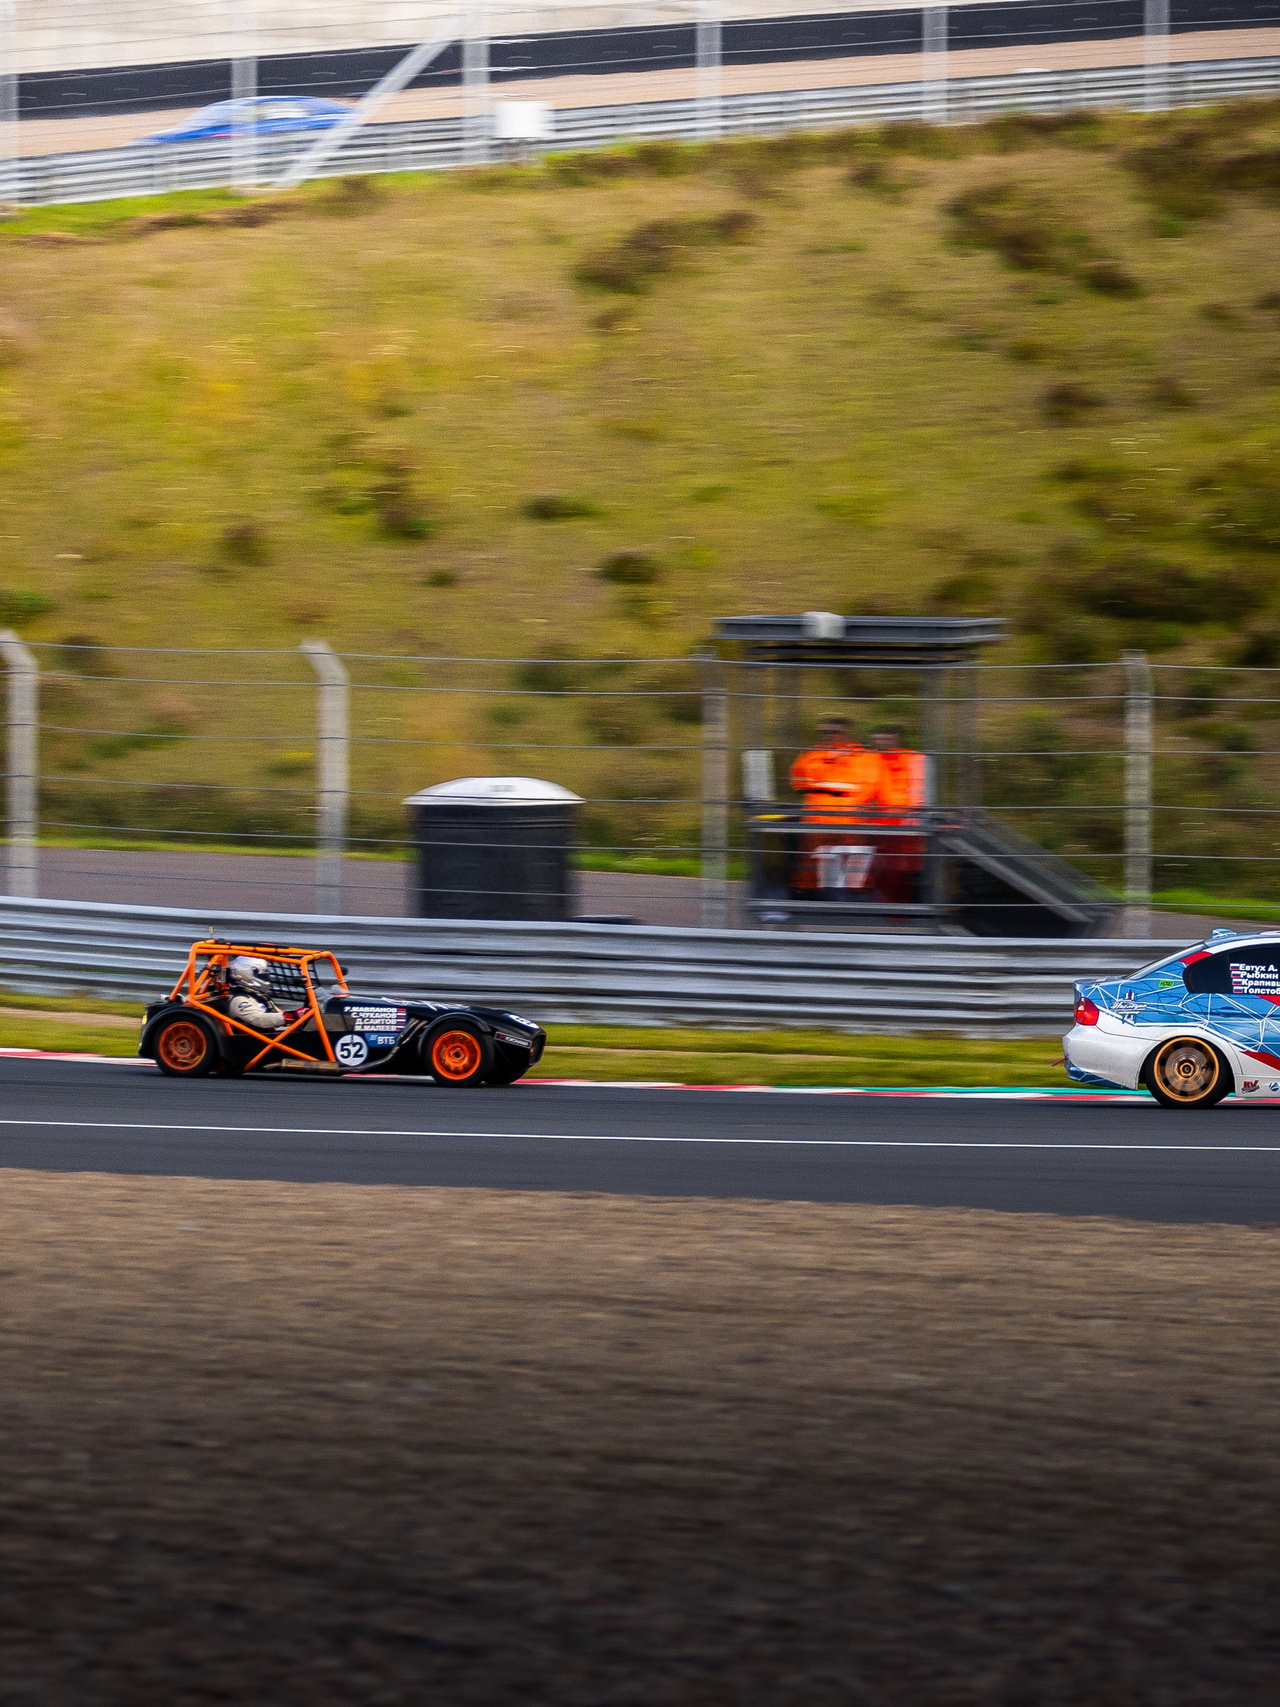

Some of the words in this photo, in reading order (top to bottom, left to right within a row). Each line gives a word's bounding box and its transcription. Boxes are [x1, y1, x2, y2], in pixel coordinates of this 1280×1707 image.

[1239, 964, 1266, 973] Евтух
[1240, 971, 1279, 979] Рыбкин
[377, 1036, 395, 1045] ВТБ
[340, 1041, 364, 1059] 52
